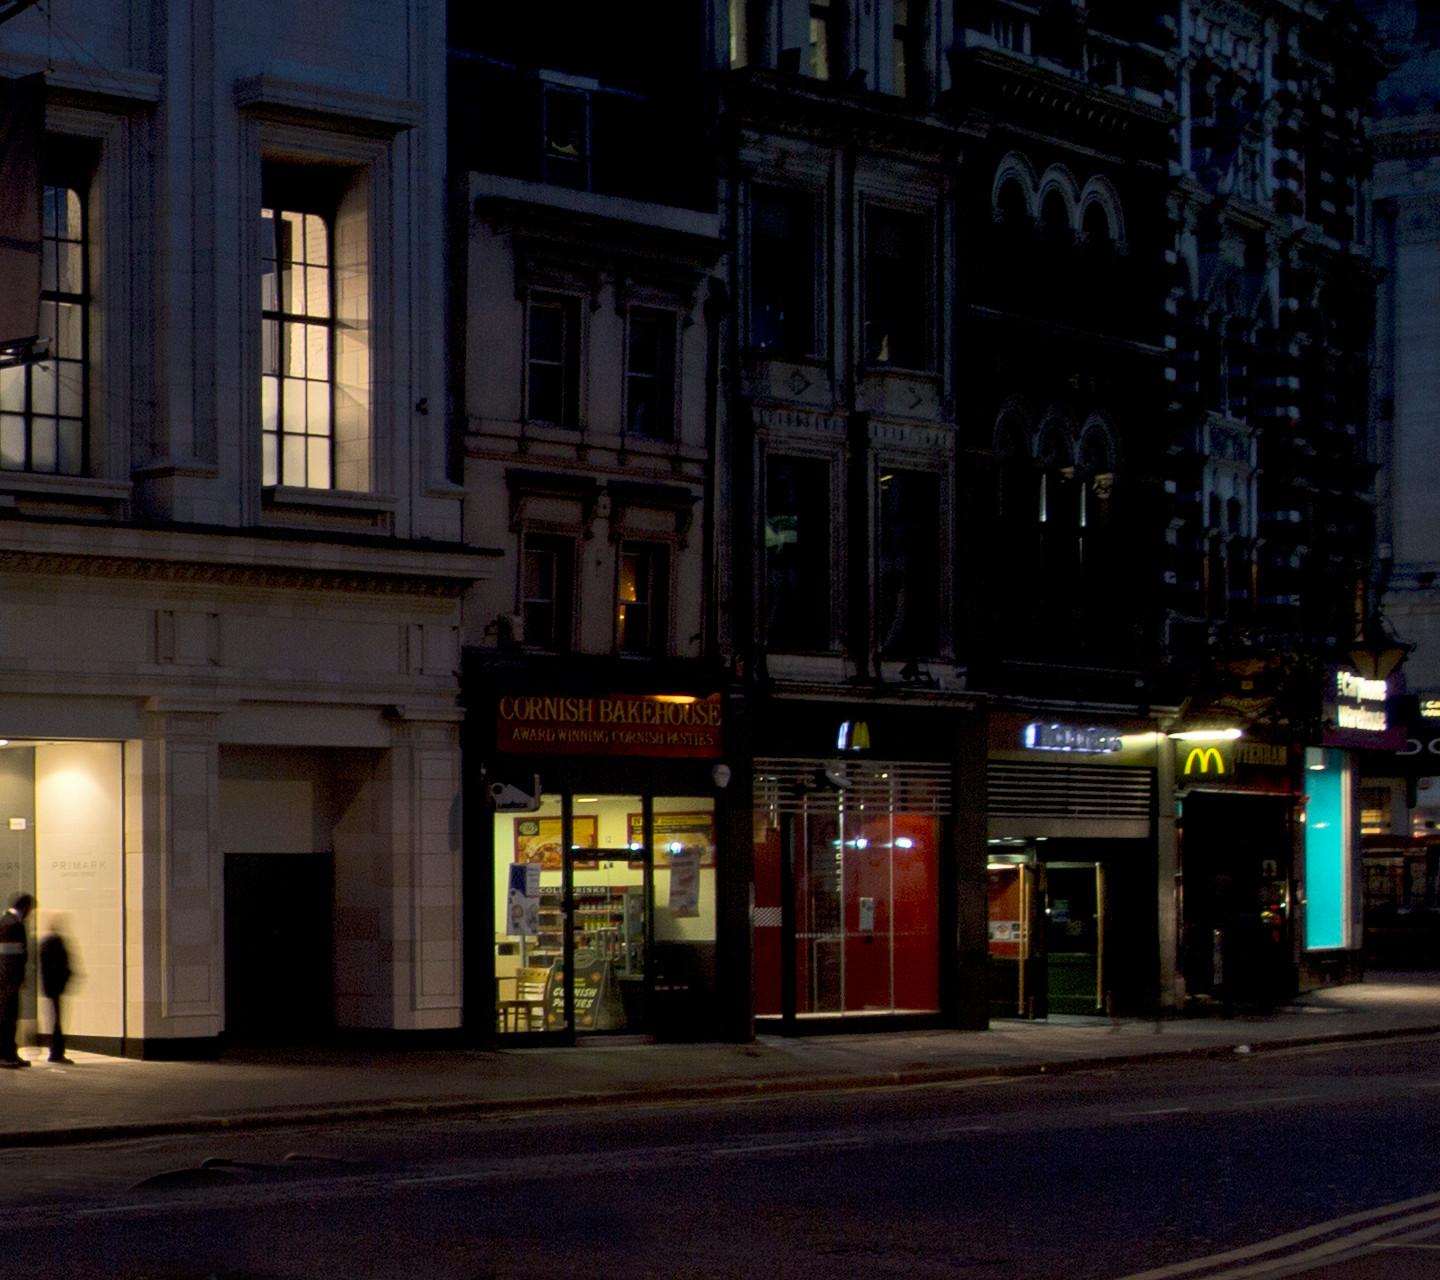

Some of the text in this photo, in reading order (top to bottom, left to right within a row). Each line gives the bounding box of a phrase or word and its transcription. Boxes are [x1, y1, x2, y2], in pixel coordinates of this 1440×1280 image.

[499, 696, 722, 727] CORNISH BAKEHOUSE
[512, 727, 556, 742] AWARD
[558, 728, 609, 744] WINNING
[611, 729, 664, 745] CORNISH
[552, 987, 599, 998] CONISH
[551, 998, 595, 1009] PATIES
